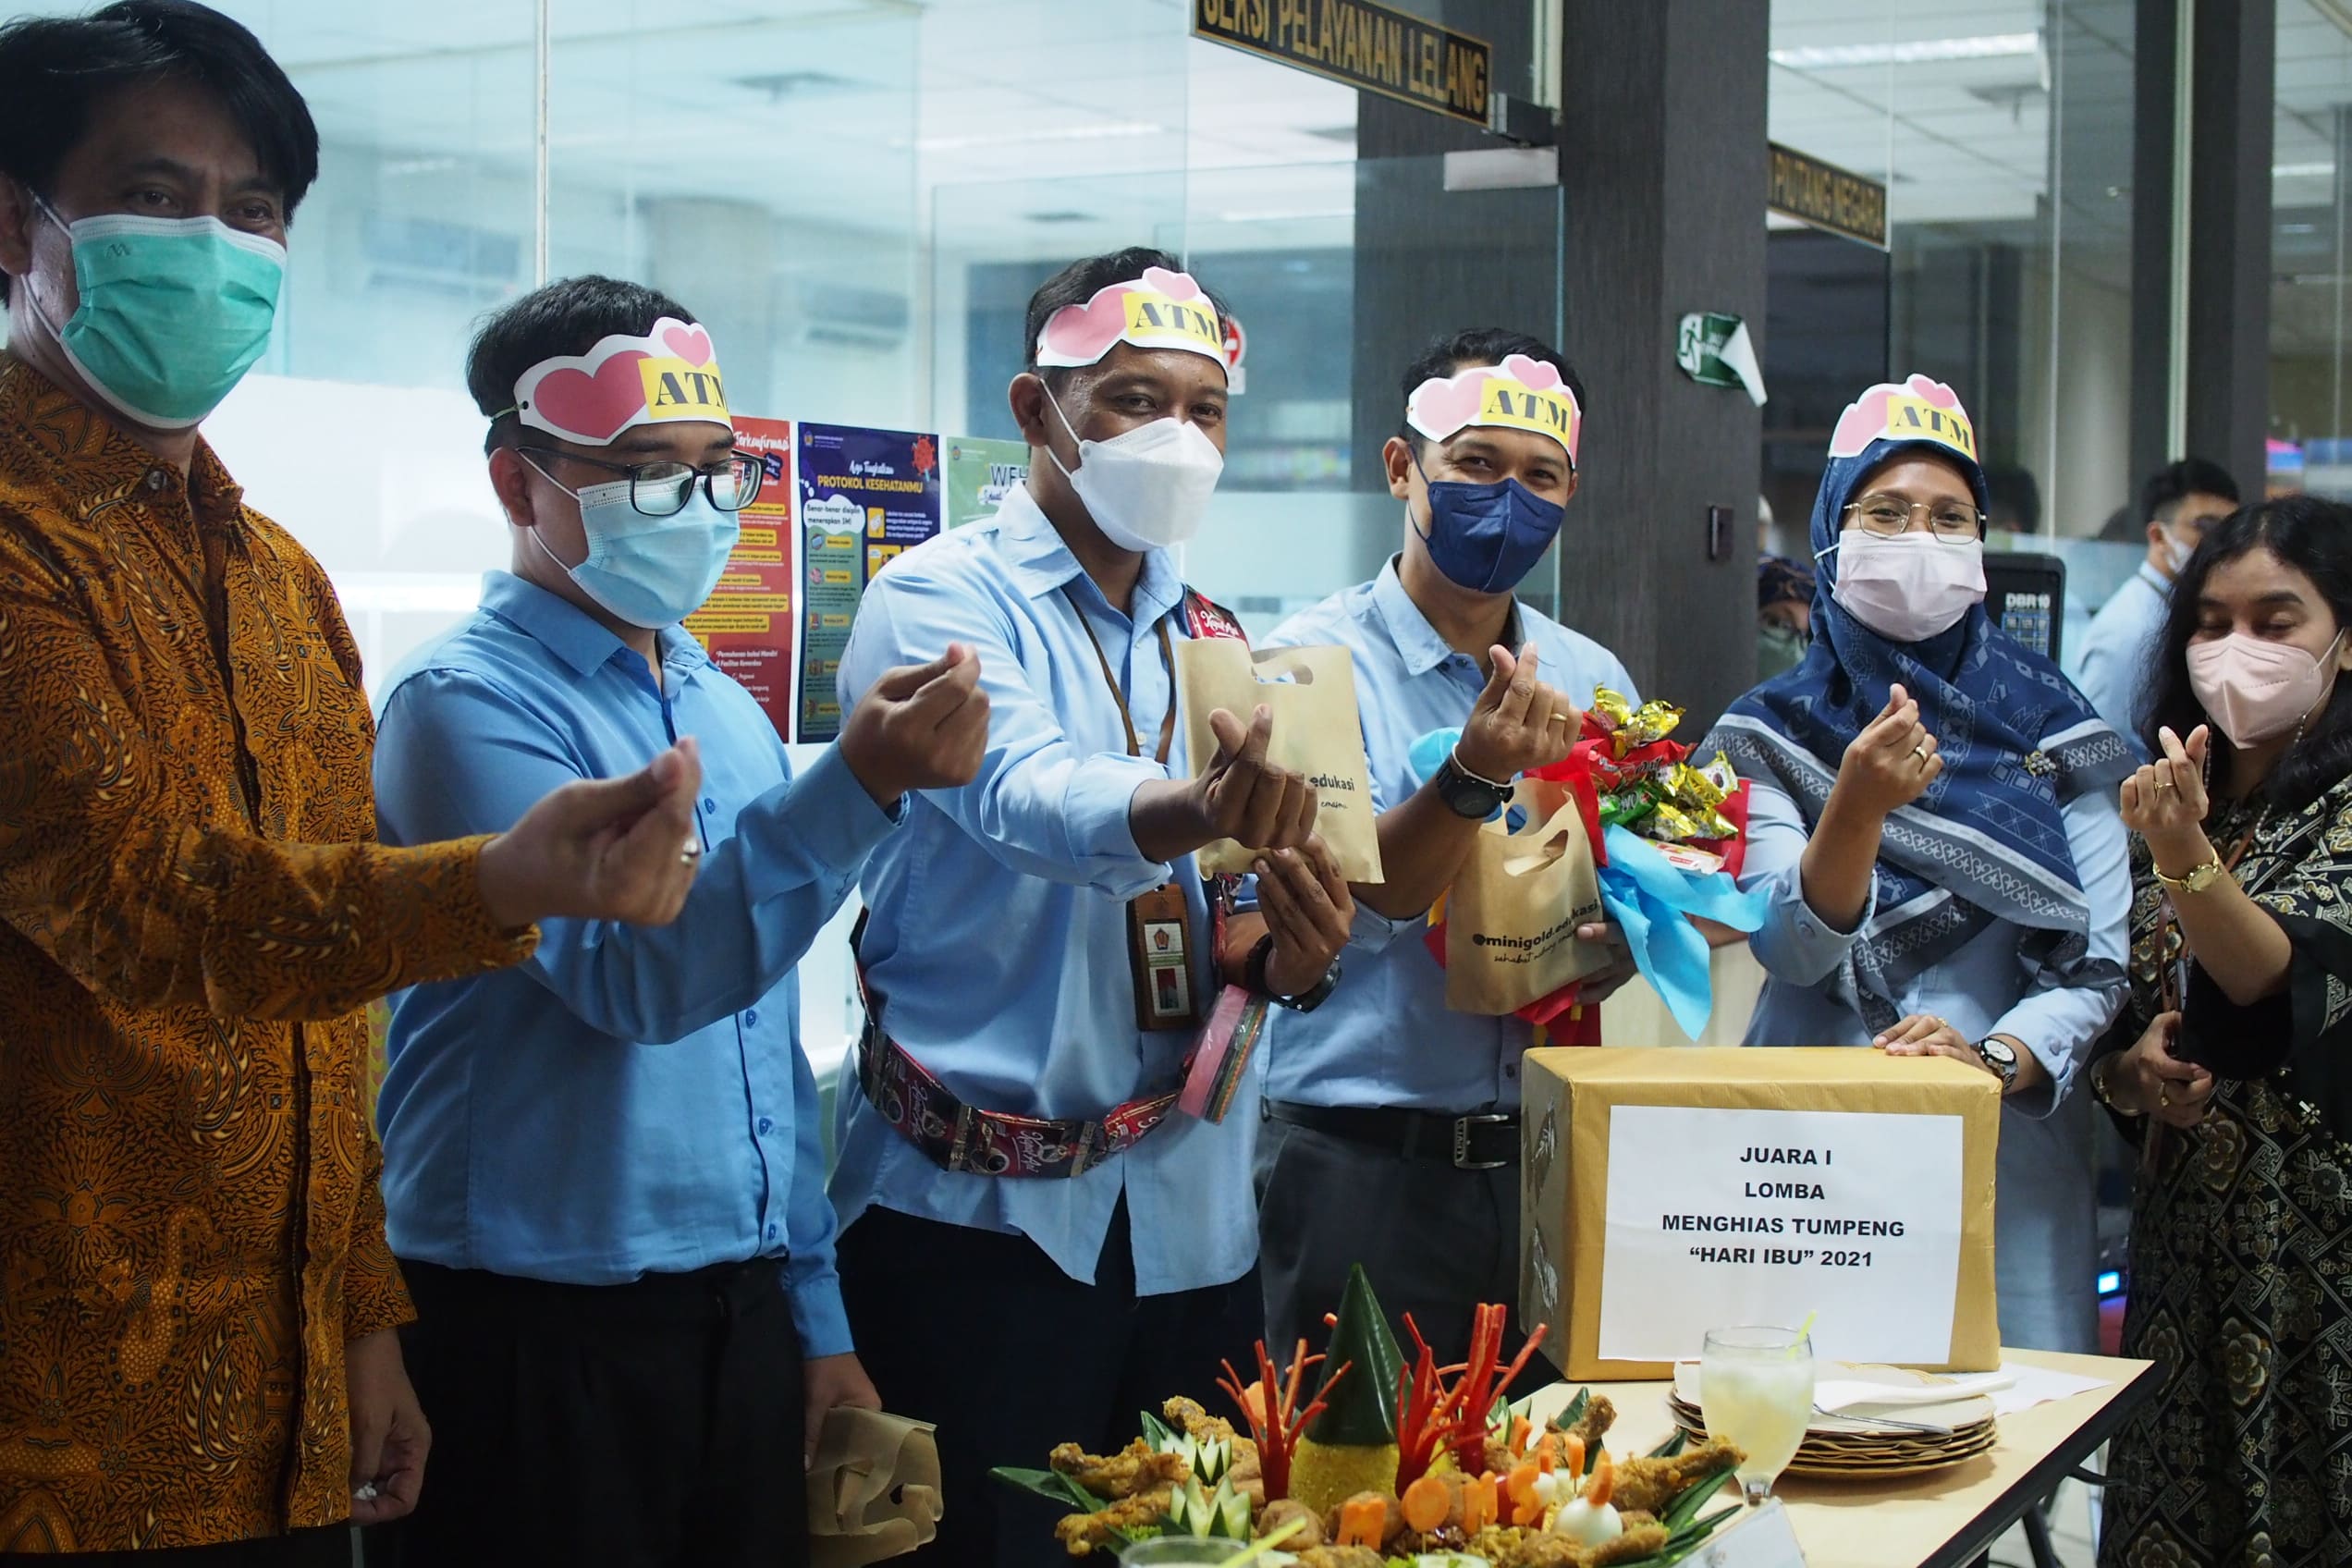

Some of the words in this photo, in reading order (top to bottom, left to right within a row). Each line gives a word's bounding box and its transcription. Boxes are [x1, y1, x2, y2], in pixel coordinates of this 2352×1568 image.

[1280, 0, 1402, 86] PELAYANAN
[1409, 28, 1486, 114] LELANG
[1134, 302, 1218, 344] ATM
[1487, 390, 1568, 434] ATM
[1894, 406, 1970, 451] ATM
[817, 474, 864, 489] PROTOKOL
[865, 477, 923, 494] KESEHATANMU
[1740, 1146, 1818, 1165] JUARA
[1826, 1149, 1831, 1165] I
[1745, 1182, 1825, 1200] LOMBA
[1662, 1214, 1784, 1233] MENGHIAS
[1792, 1218, 1905, 1237] TUMPENG
[1689, 1246, 1755, 1264] “HARI
[1763, 1248, 1814, 1265] IBU”
[1820, 1250, 1871, 1267] 2021
